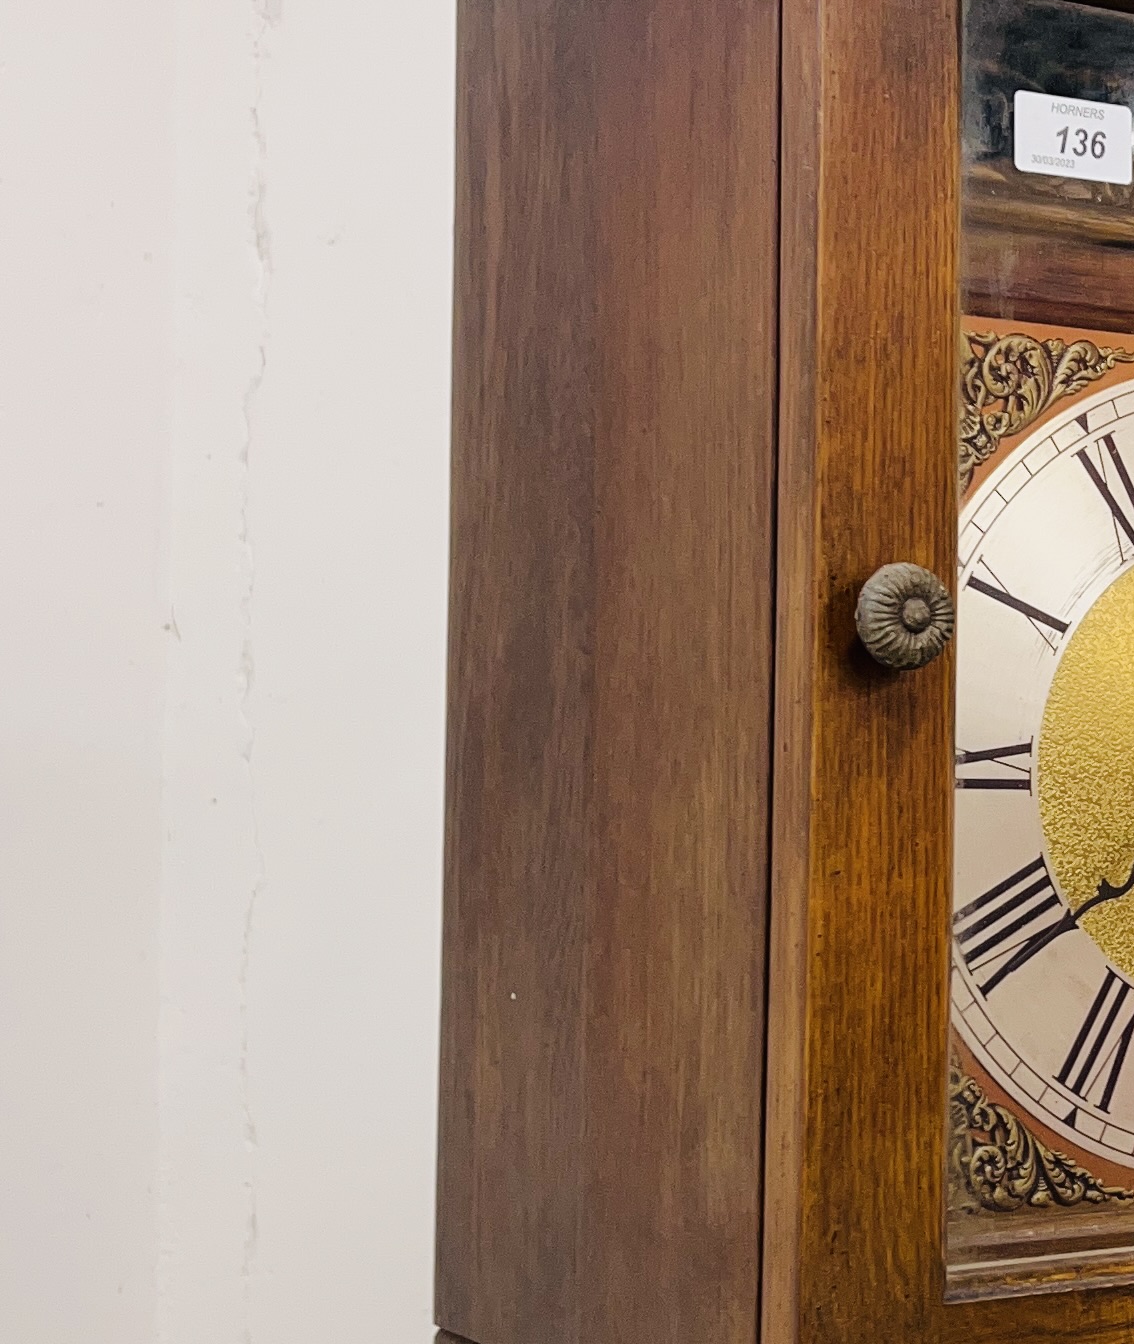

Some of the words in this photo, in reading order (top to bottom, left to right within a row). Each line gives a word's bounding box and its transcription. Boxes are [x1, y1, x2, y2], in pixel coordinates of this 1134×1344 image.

[1051, 102, 1105, 120] HORNERS
[1056, 126, 1107, 159] 136
[1031, 154, 1075, 169] 30/03/2023
[963, 554, 1072, 656] X
[953, 851, 1065, 1002] VIII
